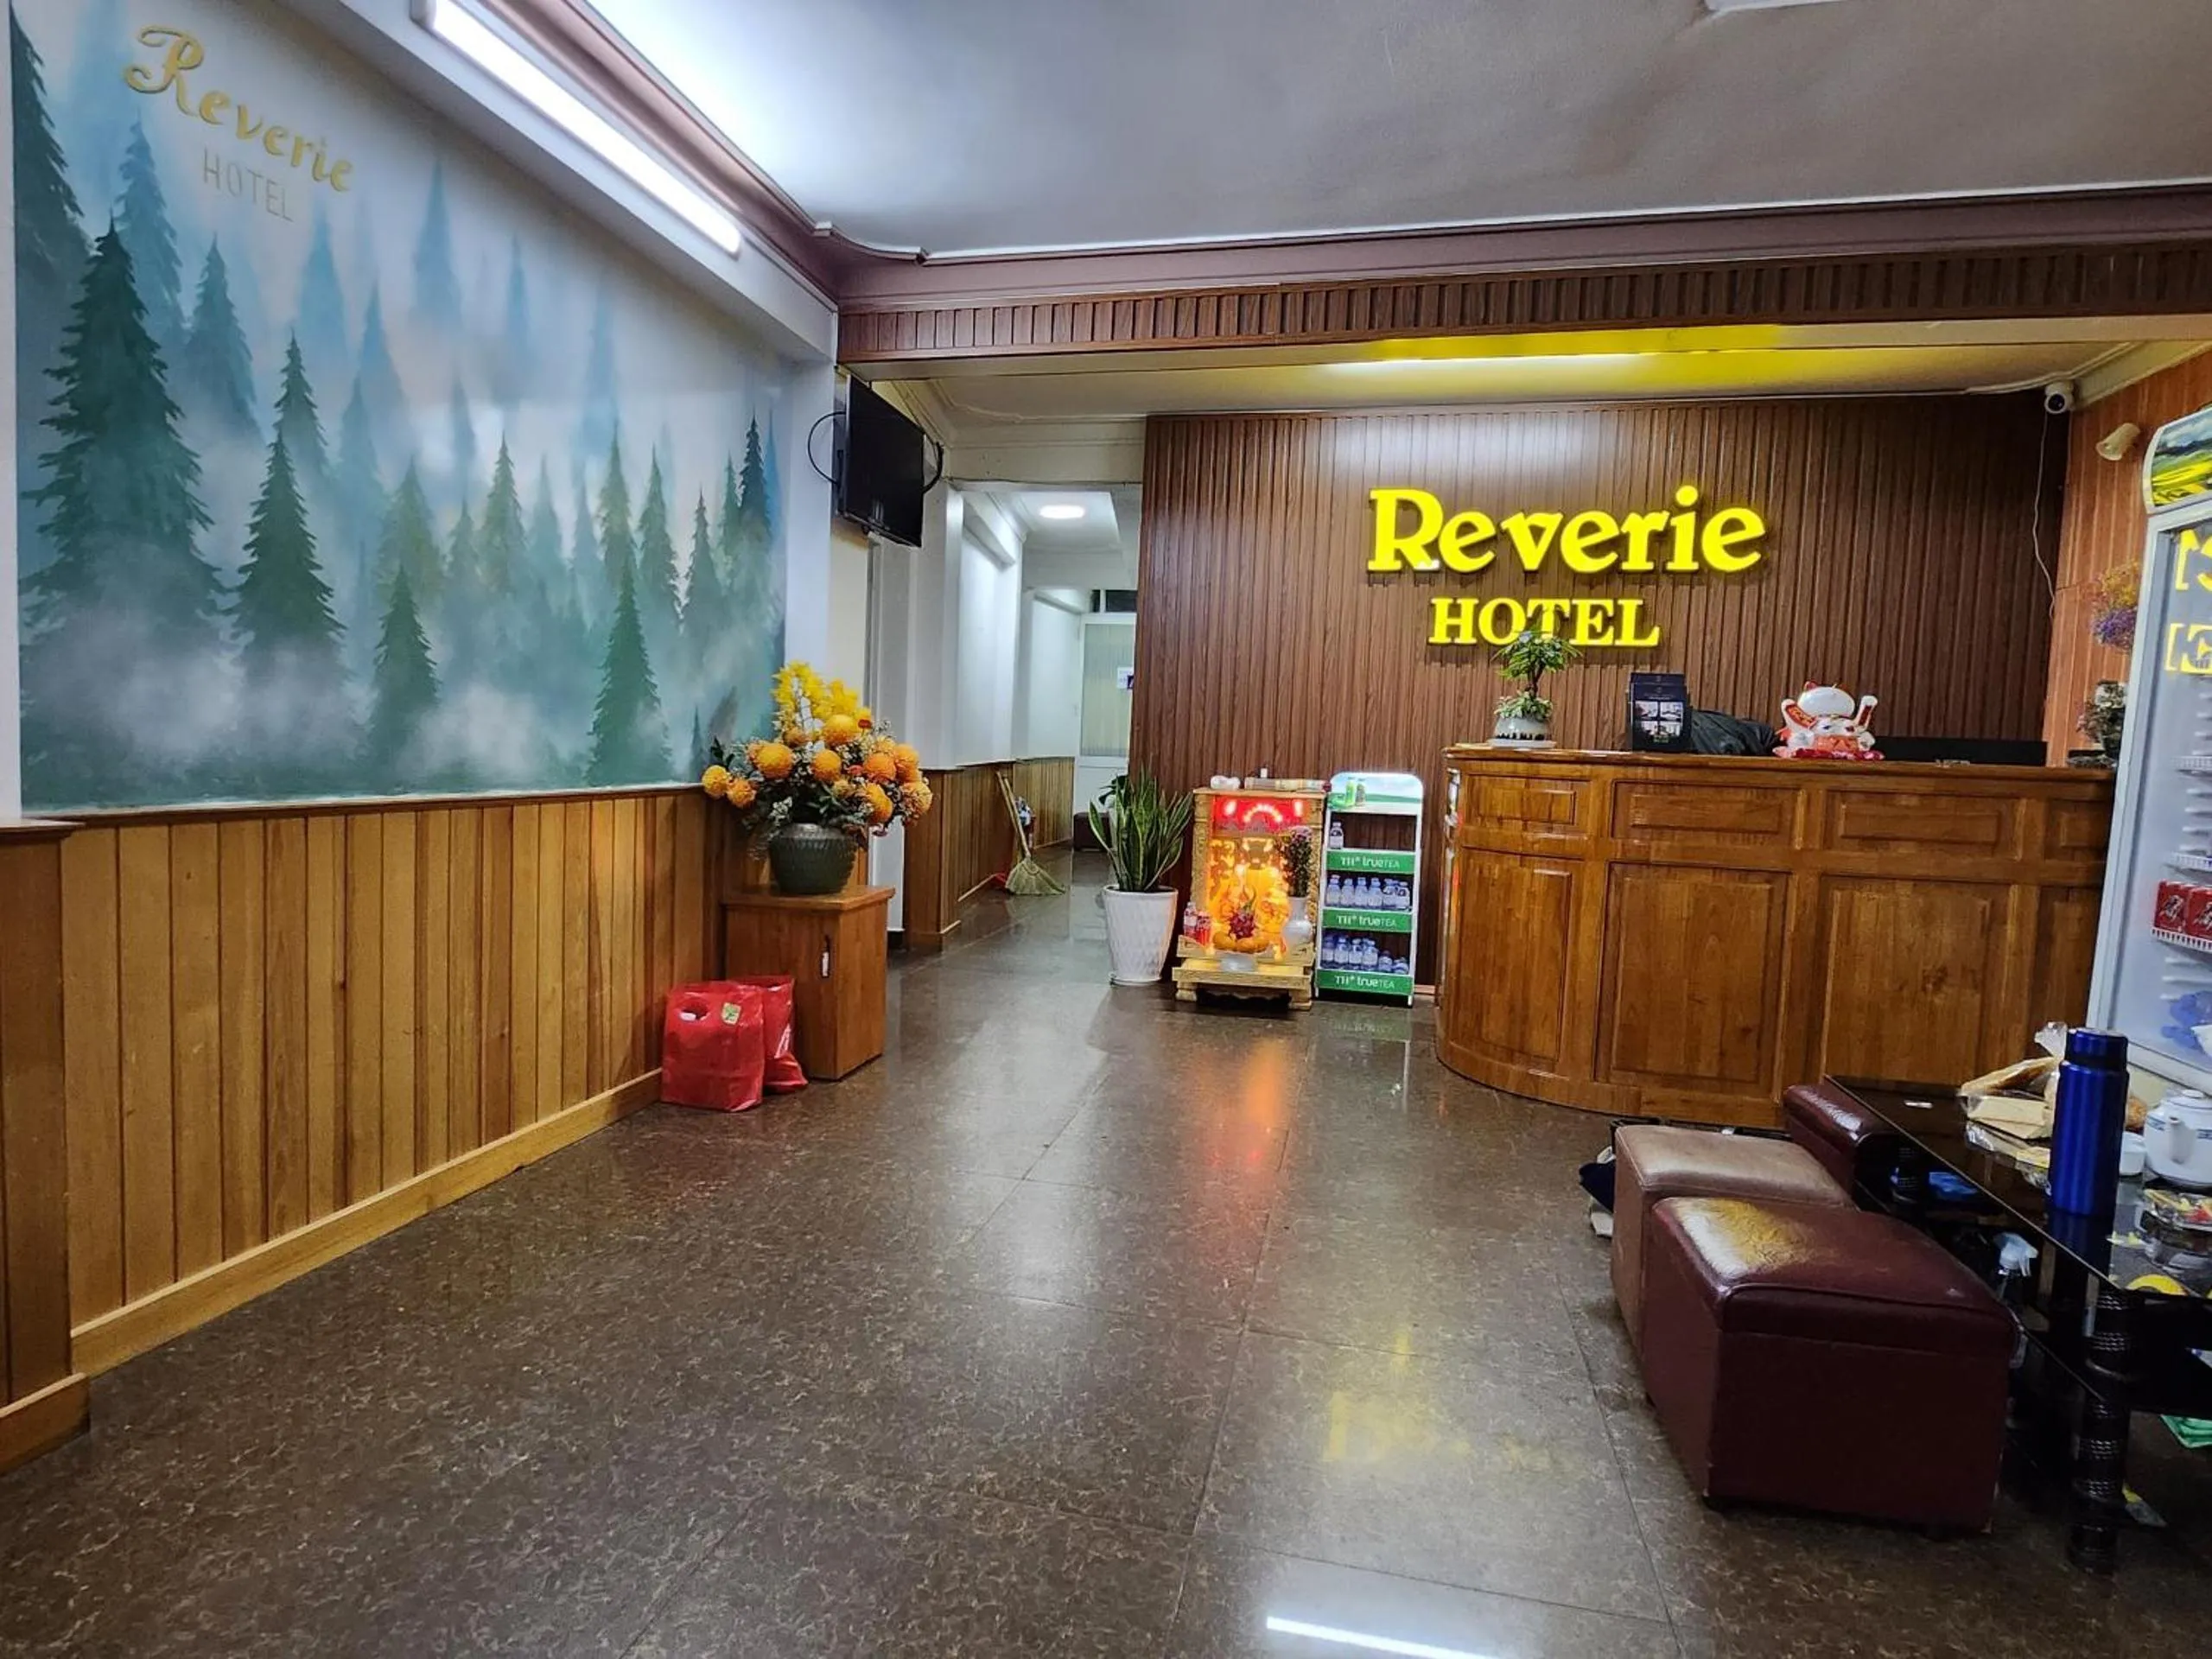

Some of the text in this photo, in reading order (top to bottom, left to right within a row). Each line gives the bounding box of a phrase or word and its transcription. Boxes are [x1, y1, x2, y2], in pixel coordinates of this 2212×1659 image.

[123, 25, 355, 193] Reverie
[202, 146, 294, 223] HOTEL
[1367, 485, 1766, 573] Reverie
[1428, 597, 1660, 647] HOTEL
